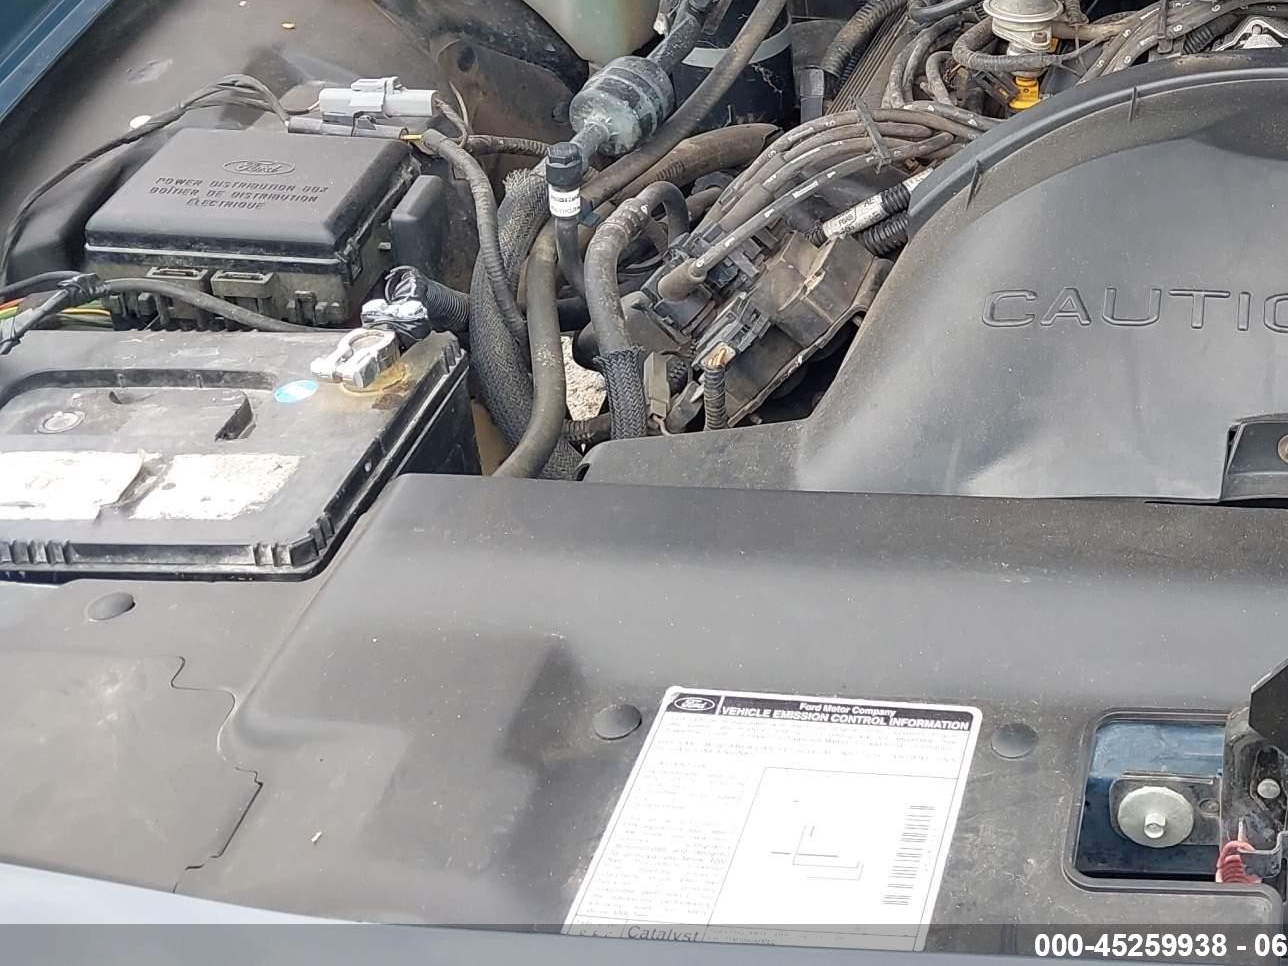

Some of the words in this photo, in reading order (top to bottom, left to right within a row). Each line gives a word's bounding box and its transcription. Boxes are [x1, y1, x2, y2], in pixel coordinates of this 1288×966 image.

[155, 177, 203, 185] POWER
[210, 180, 296, 192] DISTRIBUTION
[231, 191, 319, 203] DISTRIBUTION
[799, 702, 822, 712] Ford
[823, 705, 850, 714] Motor
[852, 706, 897, 717] Company
[721, 705, 772, 718] VEHICLE
[772, 709, 830, 722] EMISSION
[831, 714, 887, 726] CONTROL
[889, 717, 969, 730] INFORMATION
[627, 925, 700, 943] Catalyst
